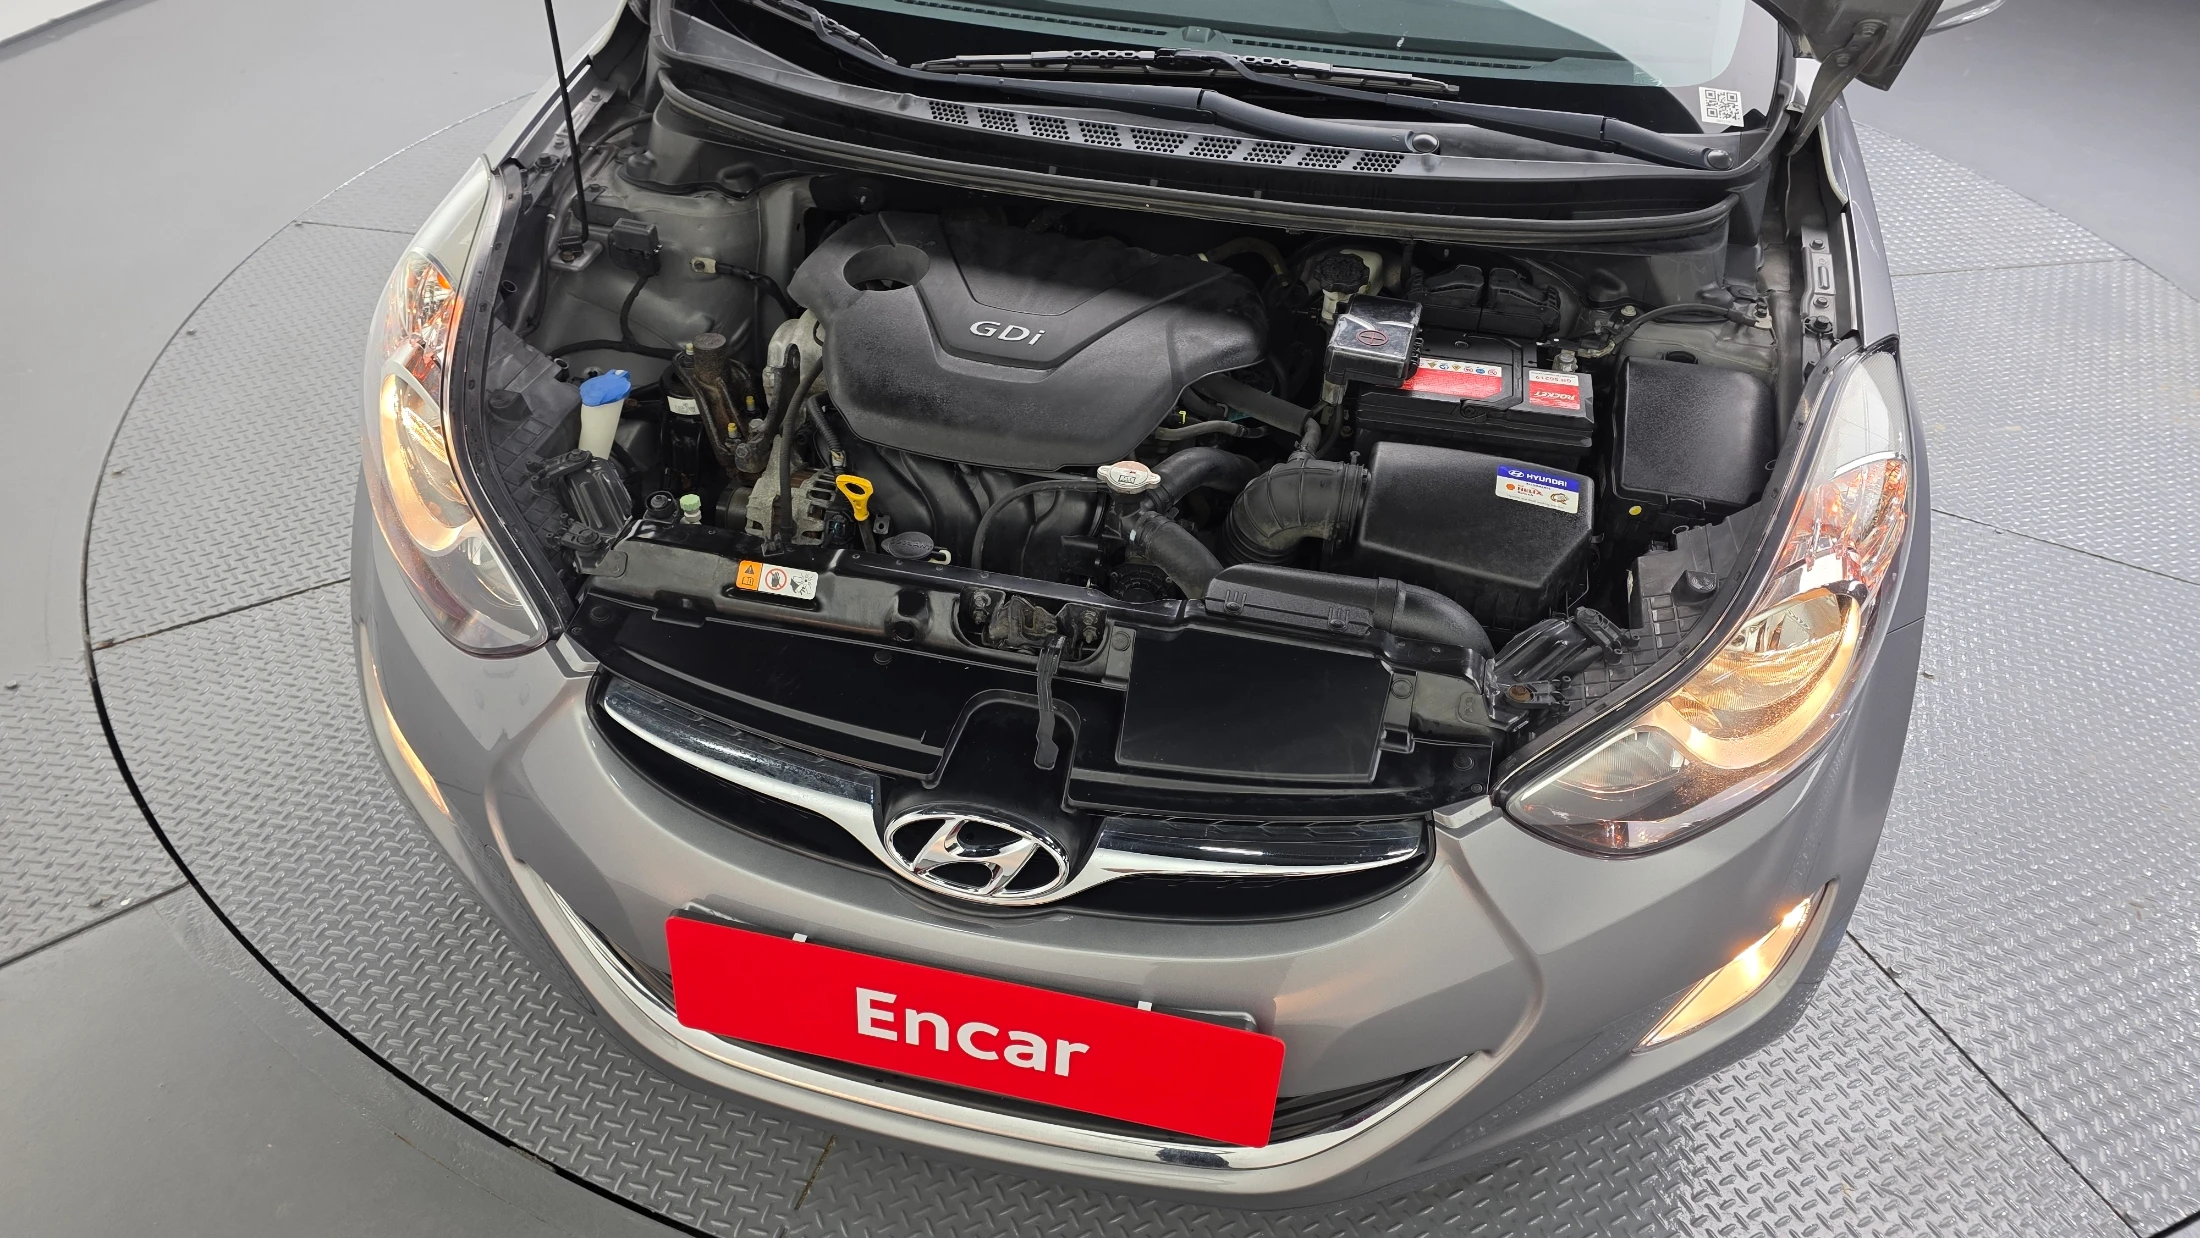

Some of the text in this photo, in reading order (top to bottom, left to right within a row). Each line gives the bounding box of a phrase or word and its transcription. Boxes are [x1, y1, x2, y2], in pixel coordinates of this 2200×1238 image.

[969, 320, 1046, 346] GDi
[1533, 390, 1576, 401] ROCKET
[1526, 473, 1568, 487] HYUNDAI
[855, 986, 1091, 1077] Encar
